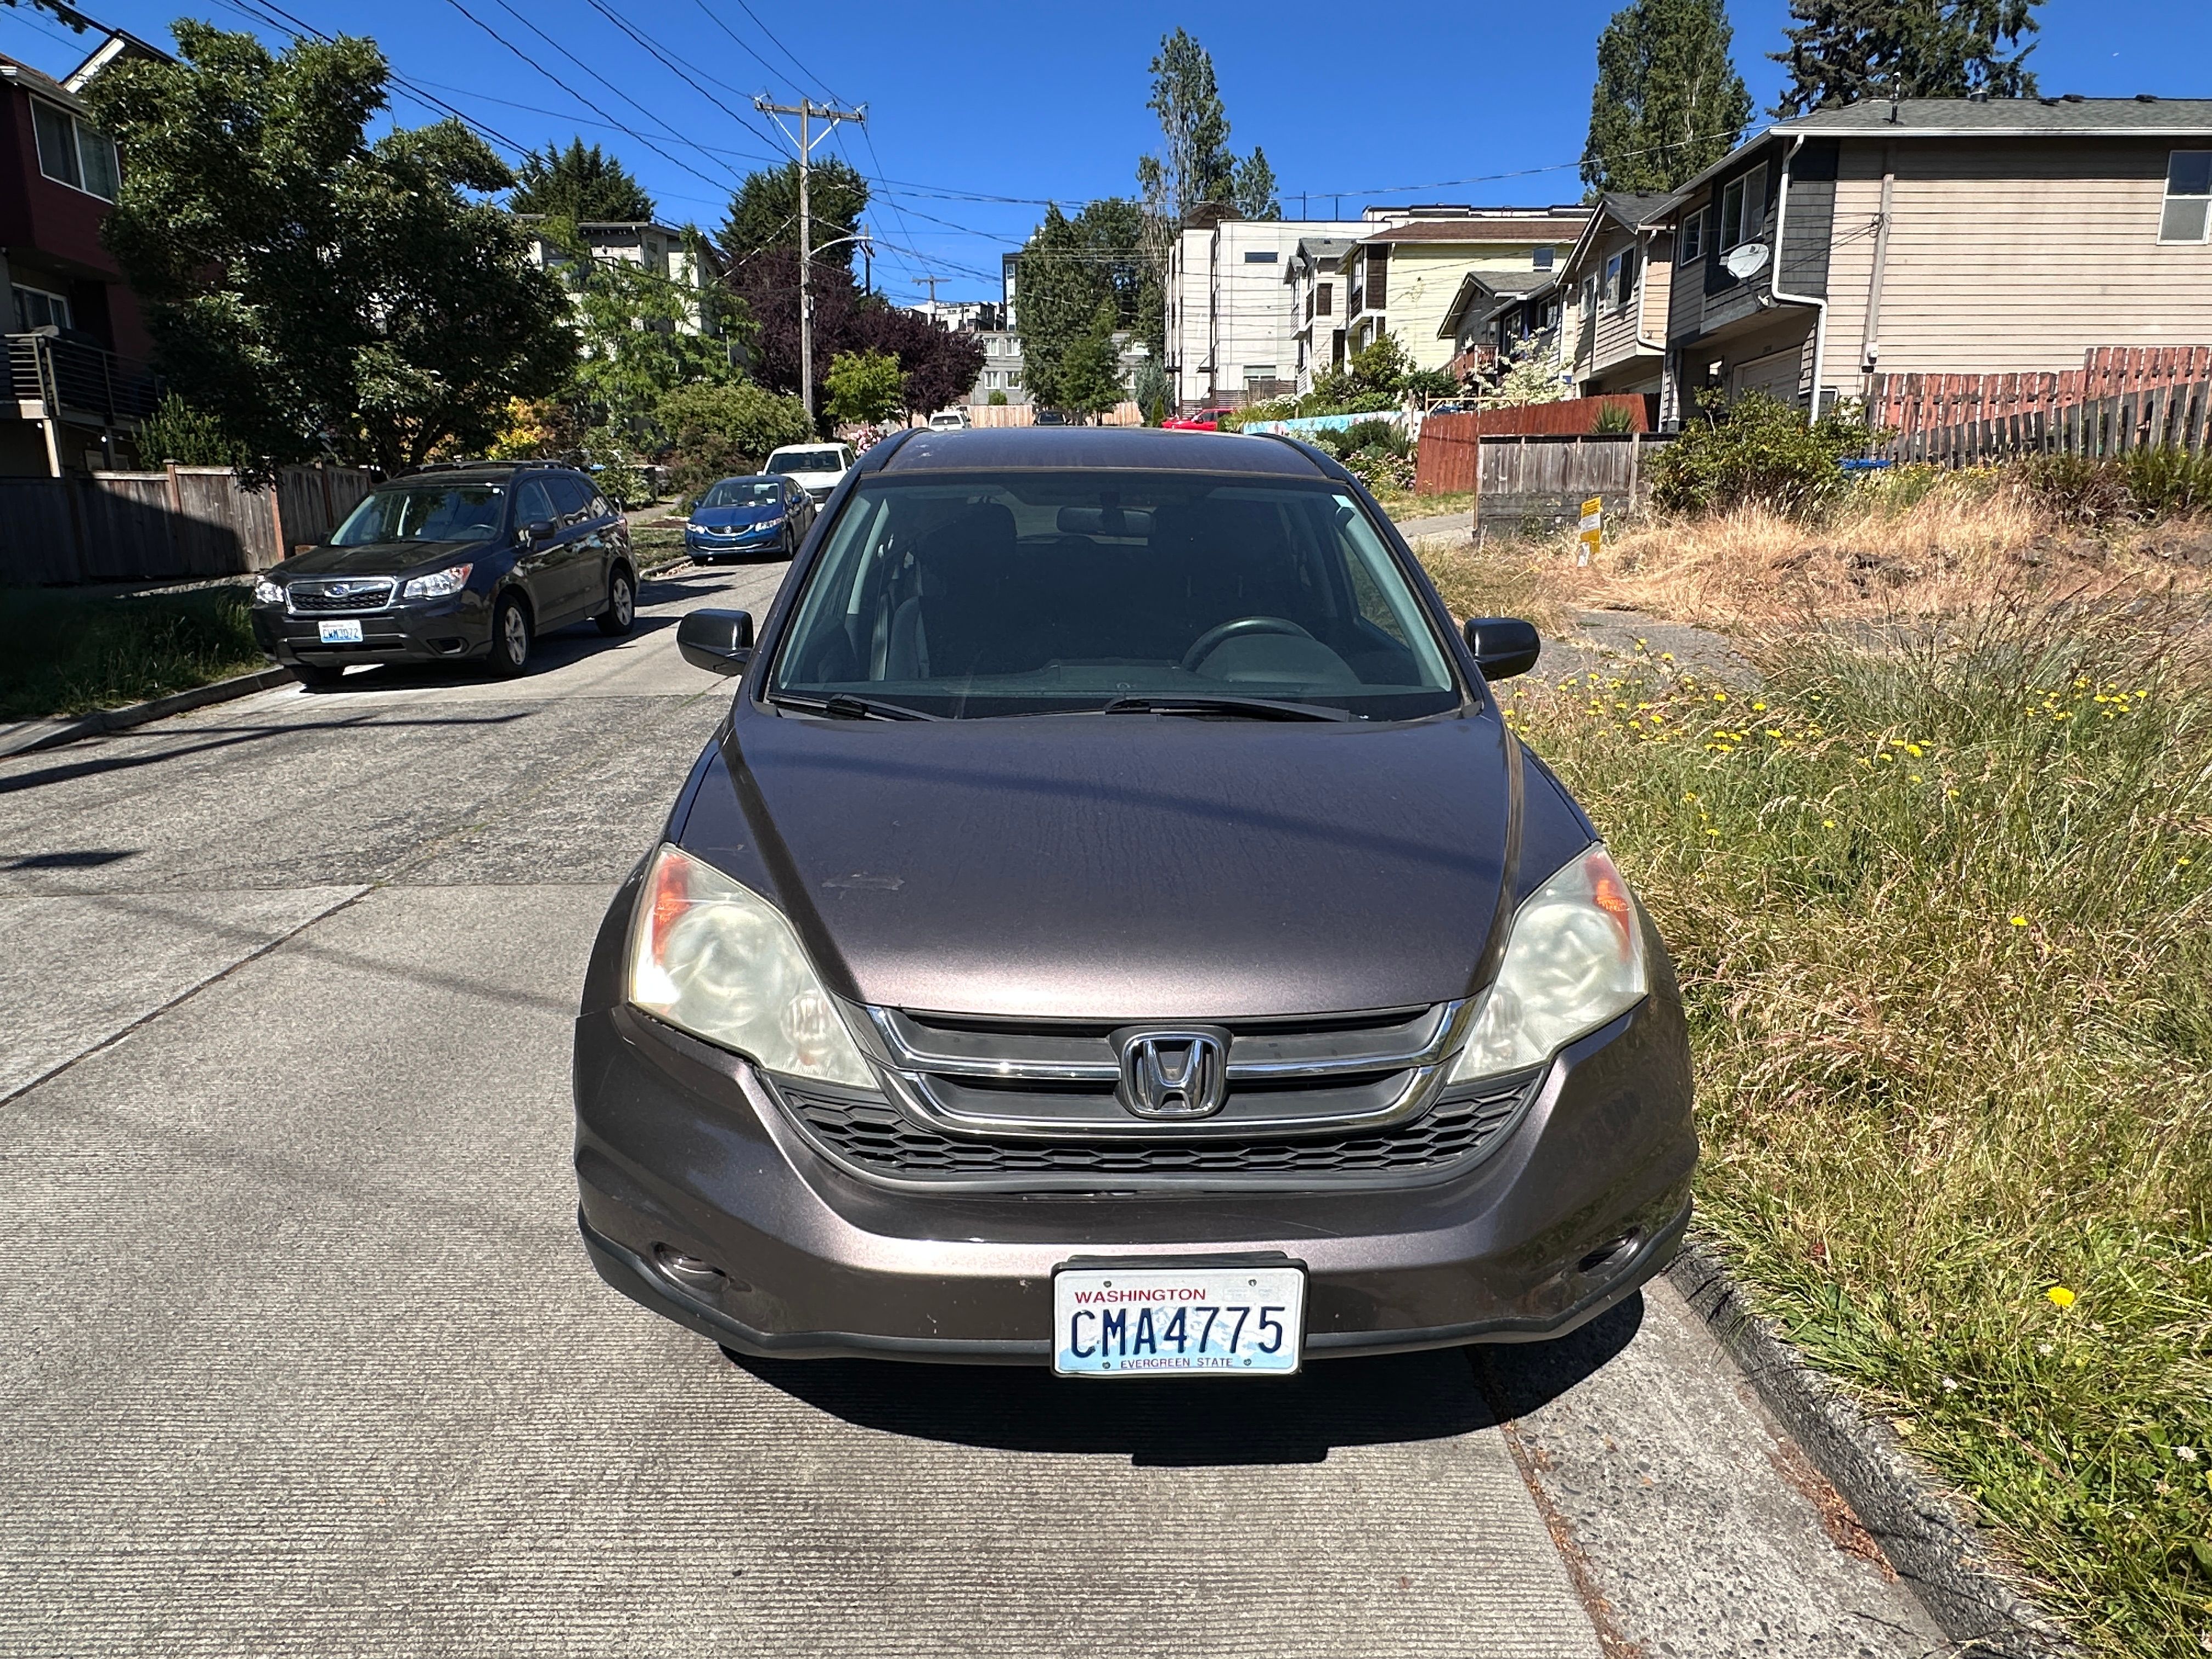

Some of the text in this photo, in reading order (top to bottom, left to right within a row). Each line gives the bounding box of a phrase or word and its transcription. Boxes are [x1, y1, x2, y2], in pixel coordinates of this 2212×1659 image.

[1075, 1289, 1206, 1304] WASHINGTON
[1071, 1306, 1285, 1358] CMA4775
[1121, 1358, 1233, 1369] EVERGREEN STATE
